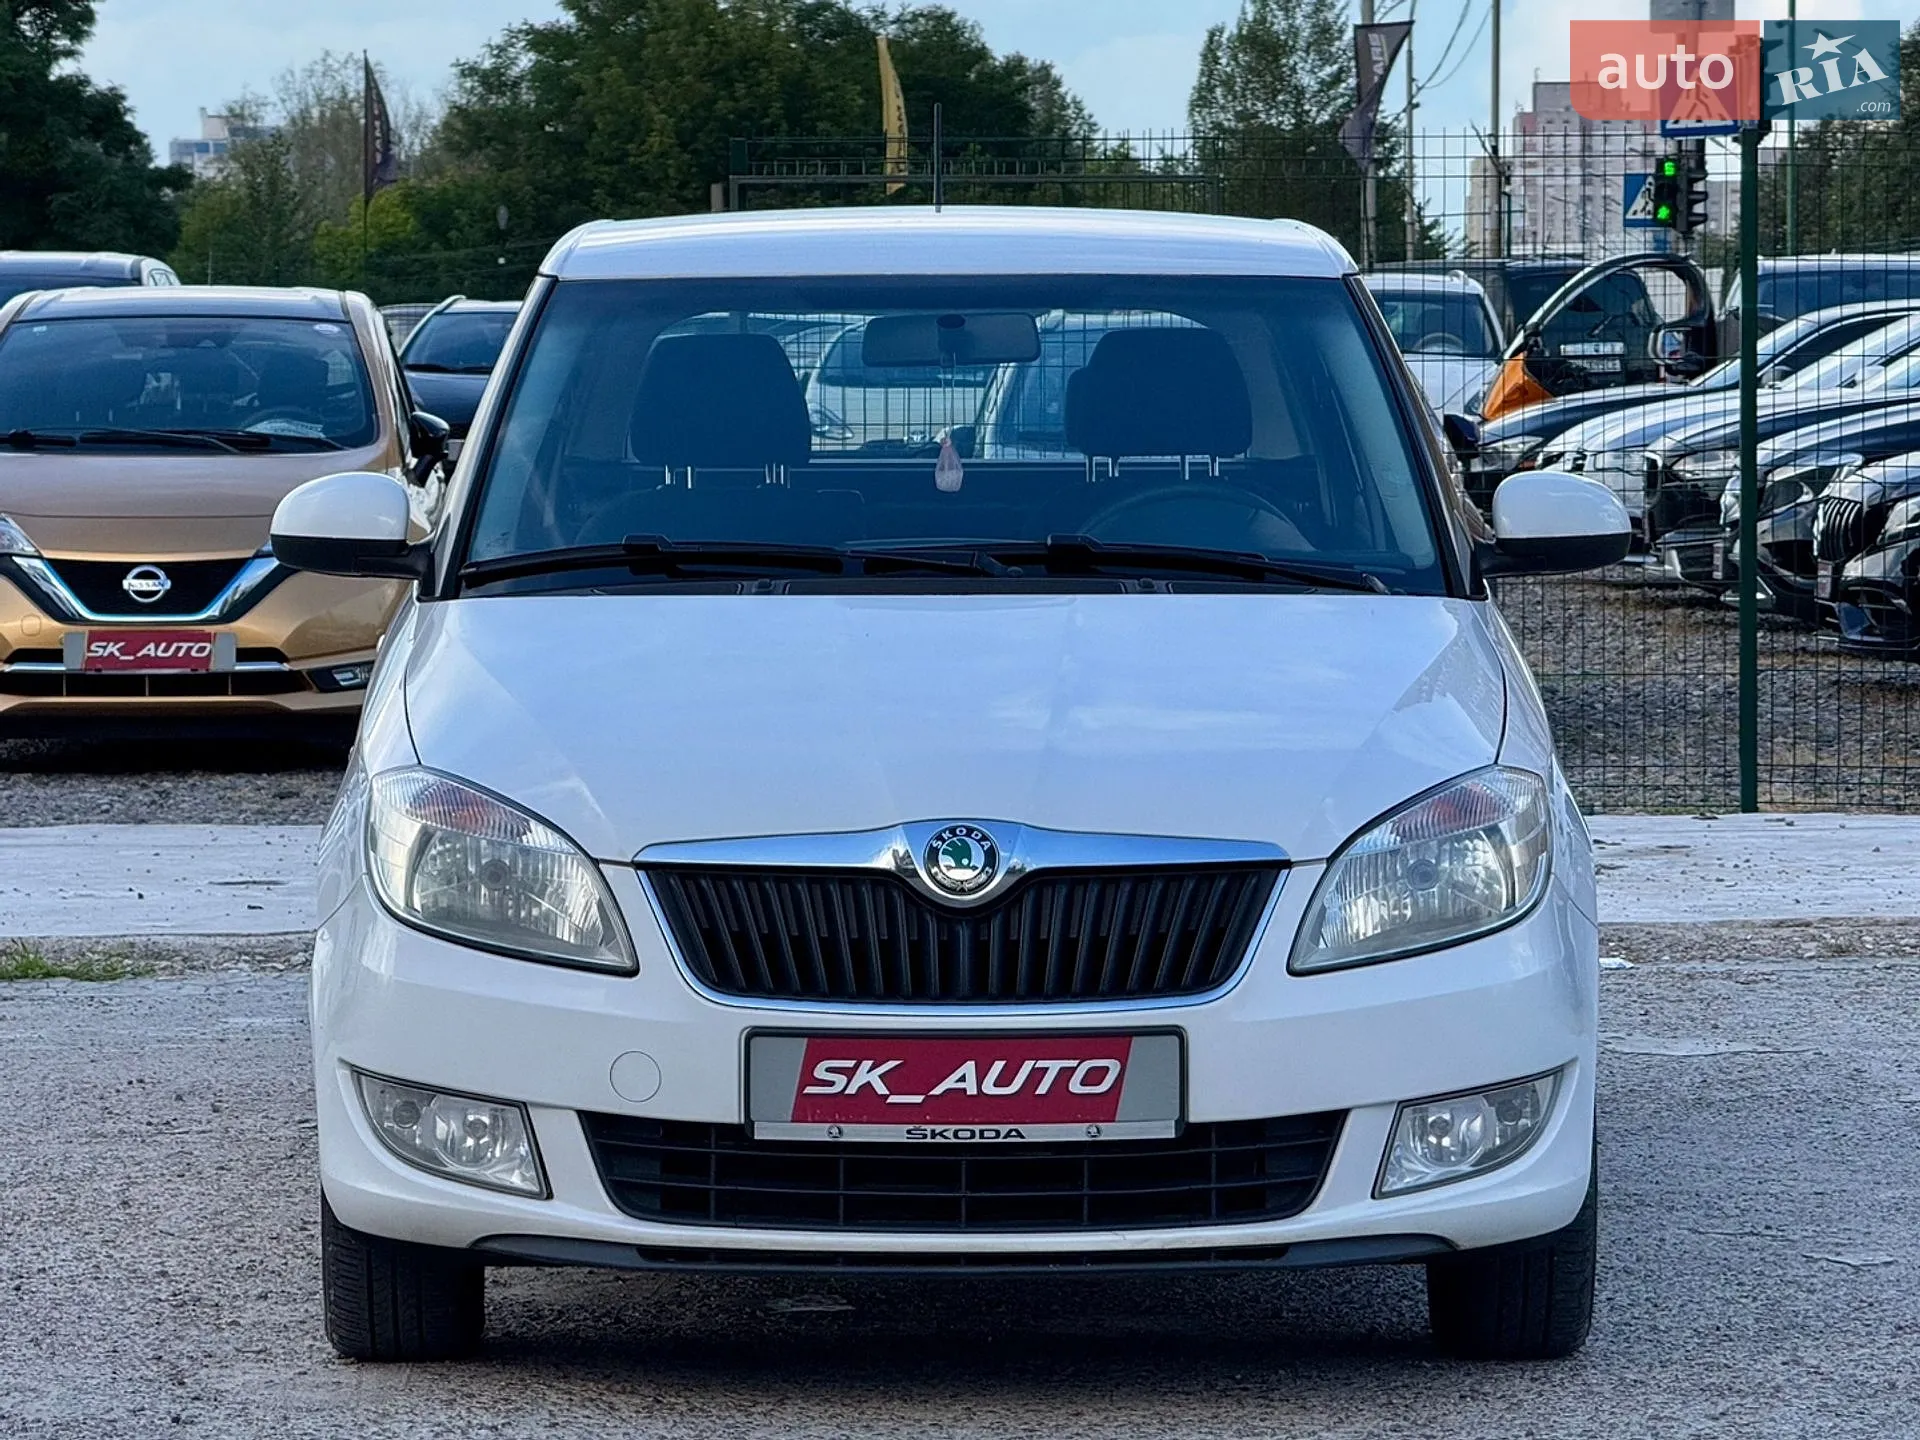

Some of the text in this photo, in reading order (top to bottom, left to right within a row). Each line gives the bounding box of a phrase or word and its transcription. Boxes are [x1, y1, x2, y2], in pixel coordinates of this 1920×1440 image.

[127, 581, 165, 590] NISSAN
[87, 641, 212, 660] SK_AUTO
[803, 1059, 1122, 1104] SK_AUTO
[905, 1125, 1026, 1140] ŠKODA
